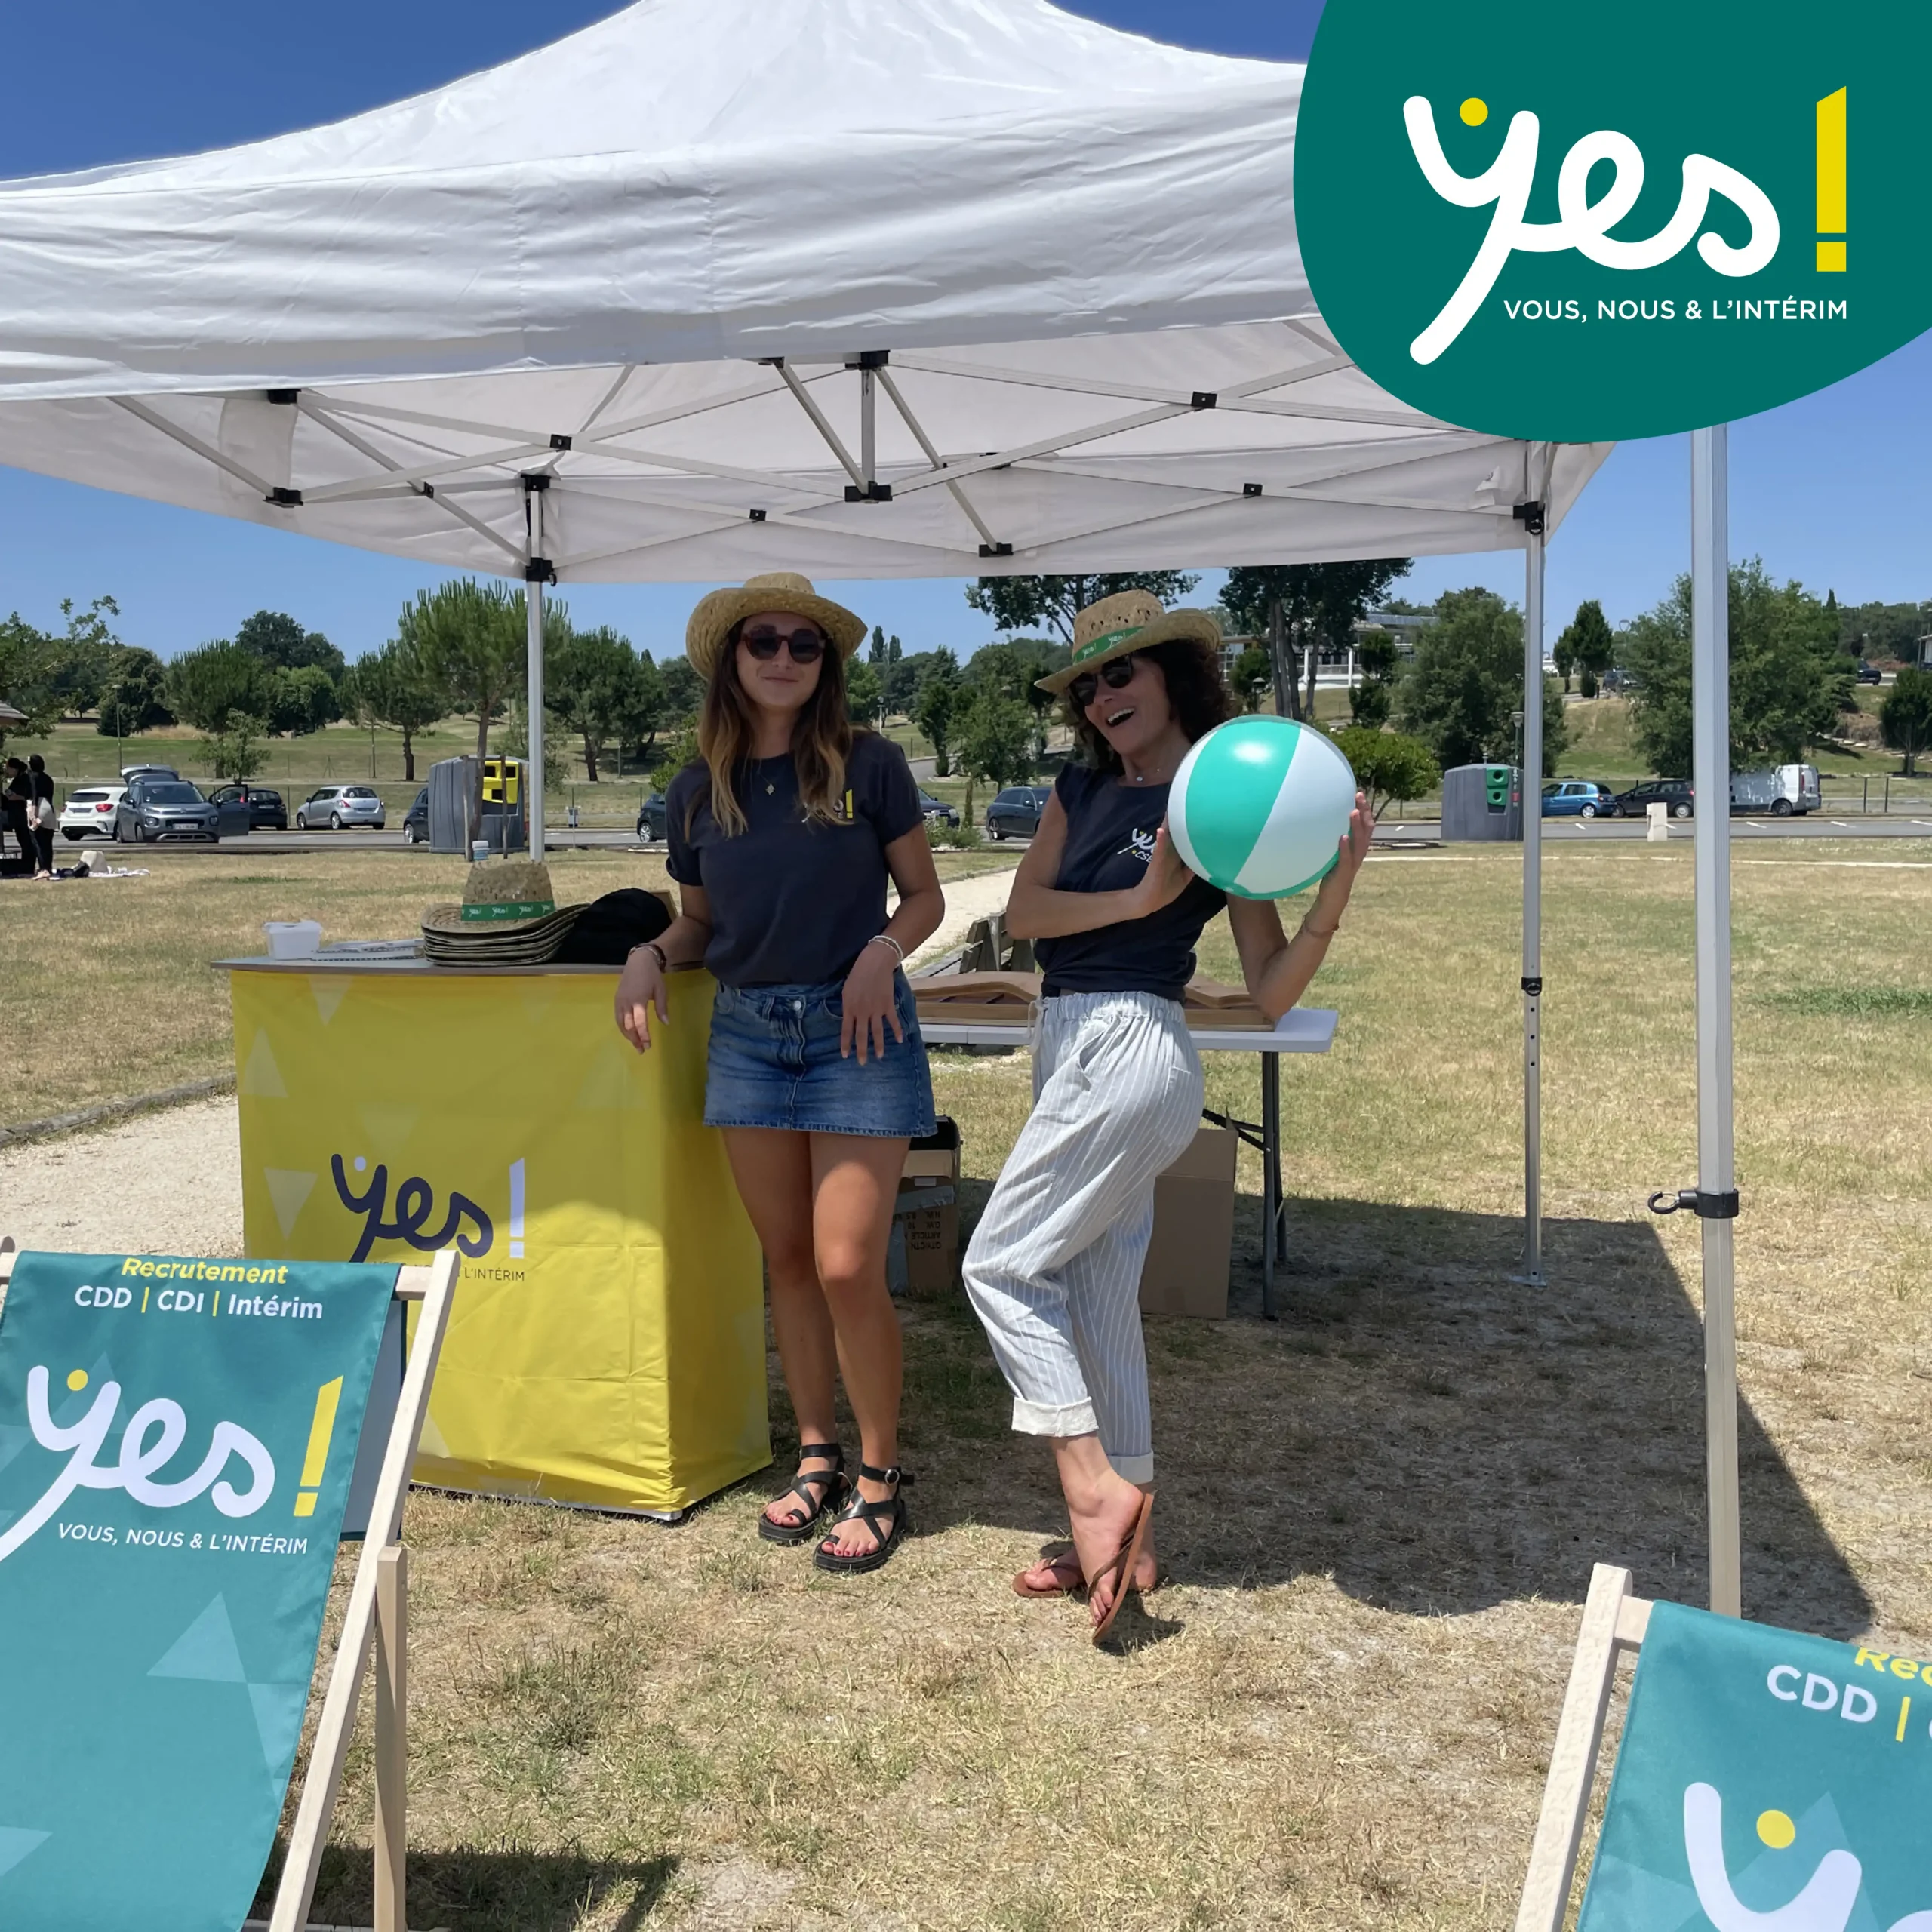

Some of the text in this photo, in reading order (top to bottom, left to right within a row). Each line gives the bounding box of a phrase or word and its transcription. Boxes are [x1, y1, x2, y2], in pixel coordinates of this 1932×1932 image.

[911, 1232, 940, 1240] ARTICLE
[122, 1257, 288, 1284] Recrutement
[75, 1285, 132, 1308] CDD
[157, 1290, 204, 1312] CDI
[227, 1294, 323, 1319] Intérim
[59, 1523, 118, 1546] VOUS,
[126, 1529, 185, 1547] NOUS
[189, 1533, 202, 1549] &
[1767, 1665, 1878, 1723] CDD
